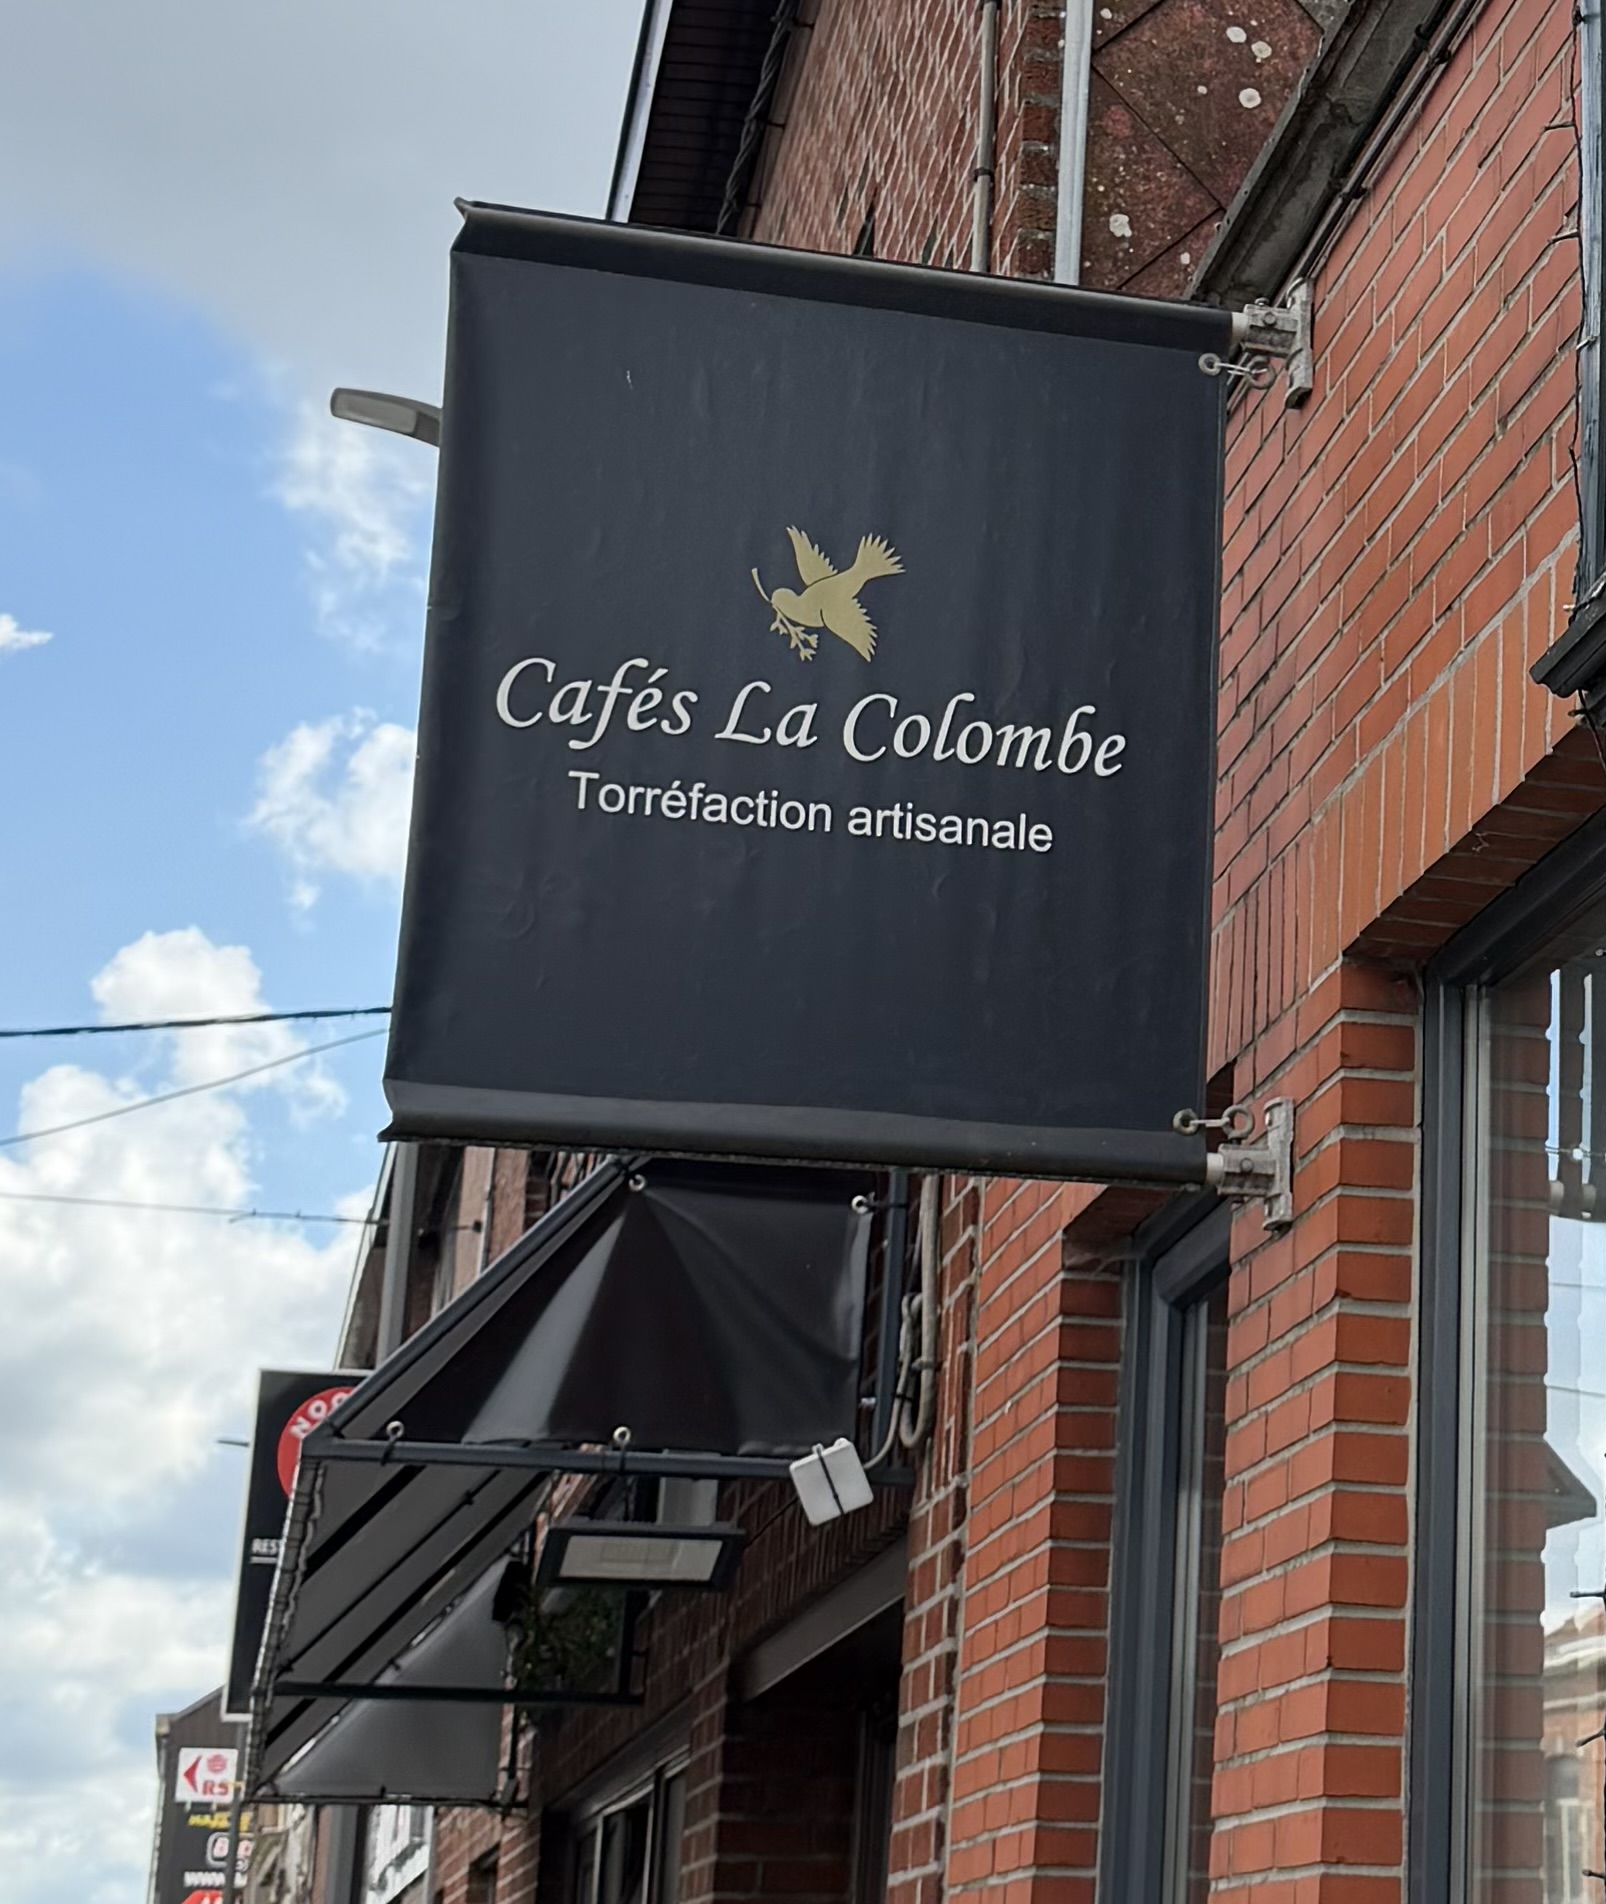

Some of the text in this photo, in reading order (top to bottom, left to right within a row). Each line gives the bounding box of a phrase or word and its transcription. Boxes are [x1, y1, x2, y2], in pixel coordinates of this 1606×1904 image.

[494, 655, 1128, 778] Cafés La Colombe
[567, 769, 1055, 854] Torréfaction artisanale
